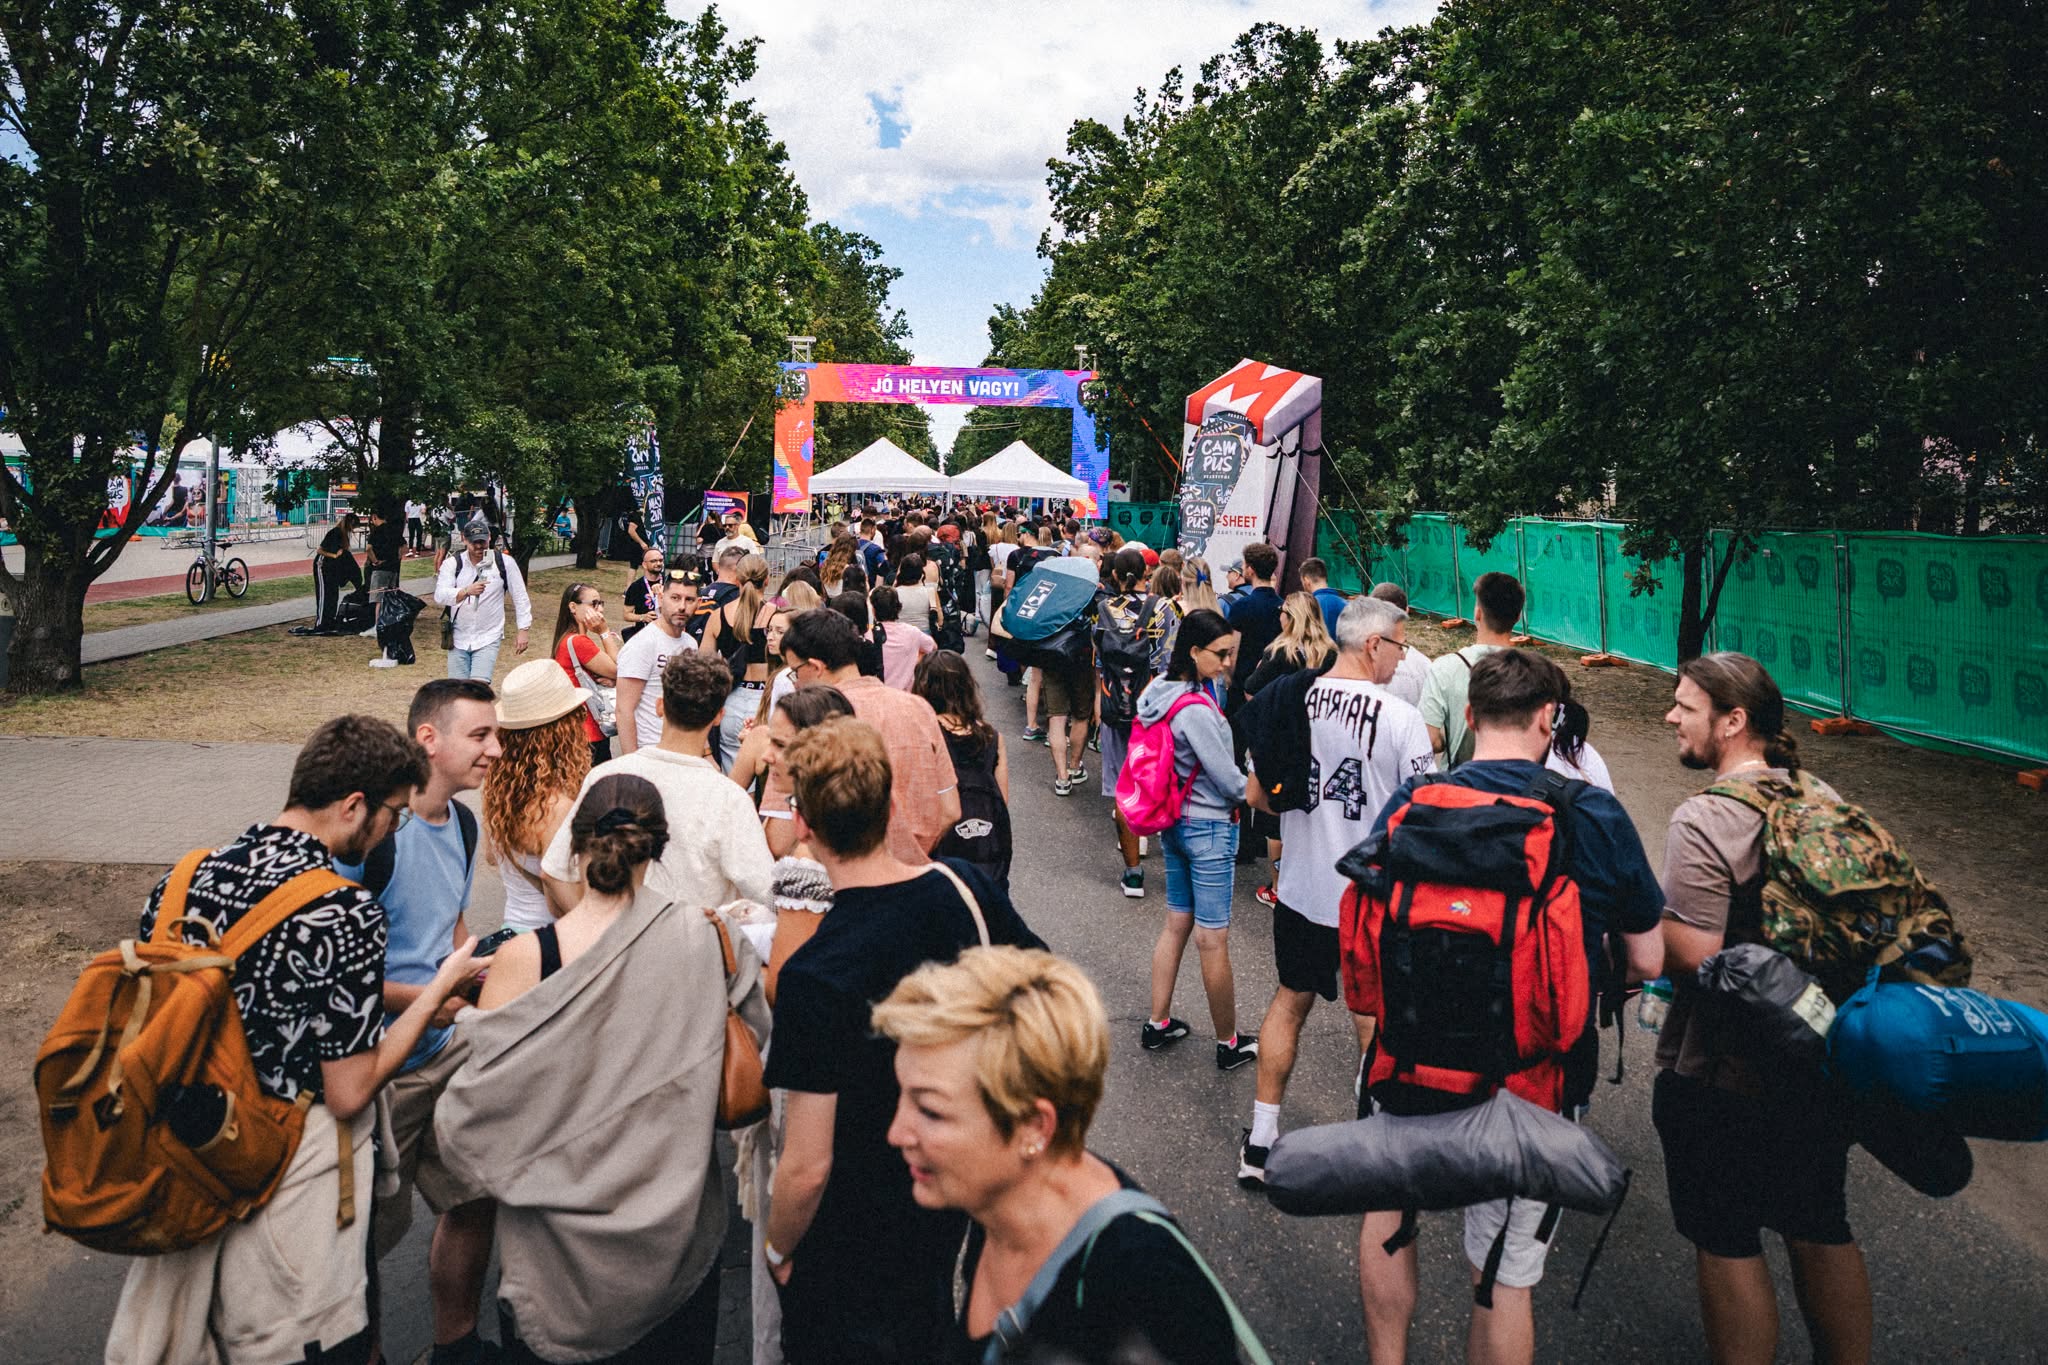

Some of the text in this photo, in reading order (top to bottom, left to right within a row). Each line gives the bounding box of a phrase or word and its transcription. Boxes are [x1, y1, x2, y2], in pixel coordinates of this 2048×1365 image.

[871, 373, 1020, 397] JÓ HELYEN VAGY!
[1201, 439, 1237, 456] CAM
[1202, 455, 1233, 472] PUS
[1185, 504, 1212, 517] CAM
[1186, 516, 1209, 529] PUS
[1217, 514, 1258, 528] -SHEET
